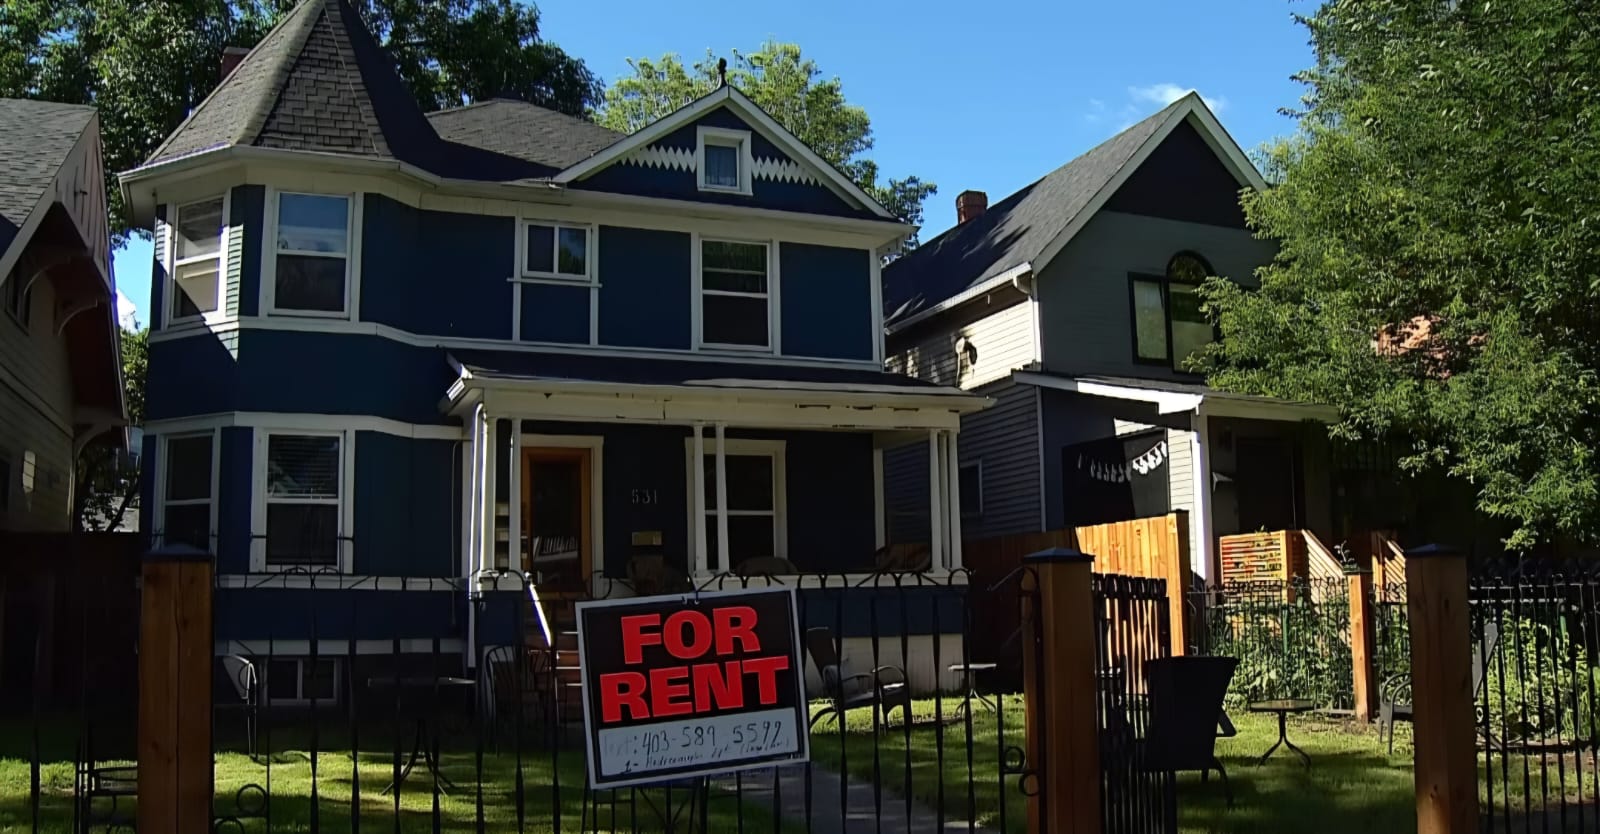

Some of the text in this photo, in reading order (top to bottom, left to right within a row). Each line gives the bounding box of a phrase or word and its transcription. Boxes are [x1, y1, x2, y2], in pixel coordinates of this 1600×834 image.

[631, 488, 658, 505] 531
[621, 606, 761, 665] FOR
[600, 655, 789, 723] RENT
